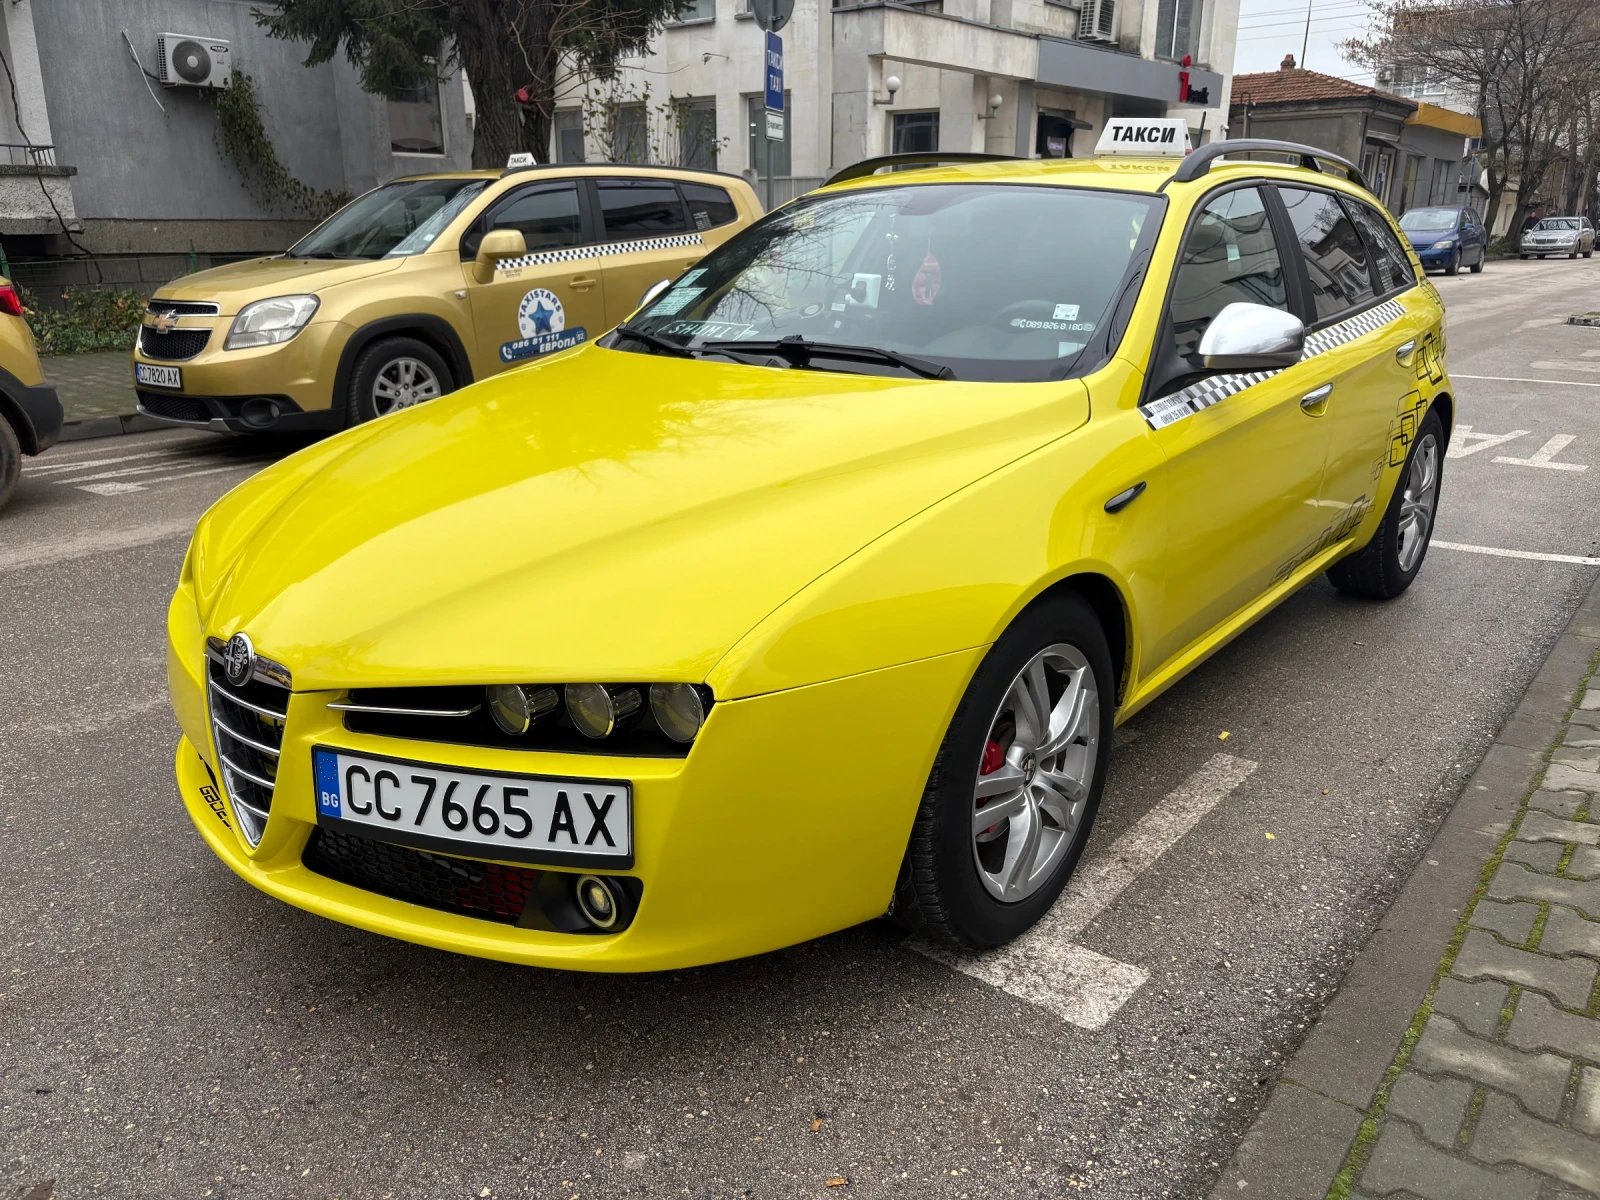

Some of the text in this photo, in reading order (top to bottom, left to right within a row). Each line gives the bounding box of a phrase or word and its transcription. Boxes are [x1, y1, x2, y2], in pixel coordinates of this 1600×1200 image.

[767, 50, 782, 71] ТАКСИ
[770, 75, 781, 93] TAXI
[1112, 126, 1176, 143] ТАКСИ
[519, 290, 562, 319] TAXISTARS
[512, 333, 560, 350] 086 81 111
[540, 337, 576, 353] ЕВРОПА
[321, 791, 339, 808] BG
[547, 790, 617, 847] AX
